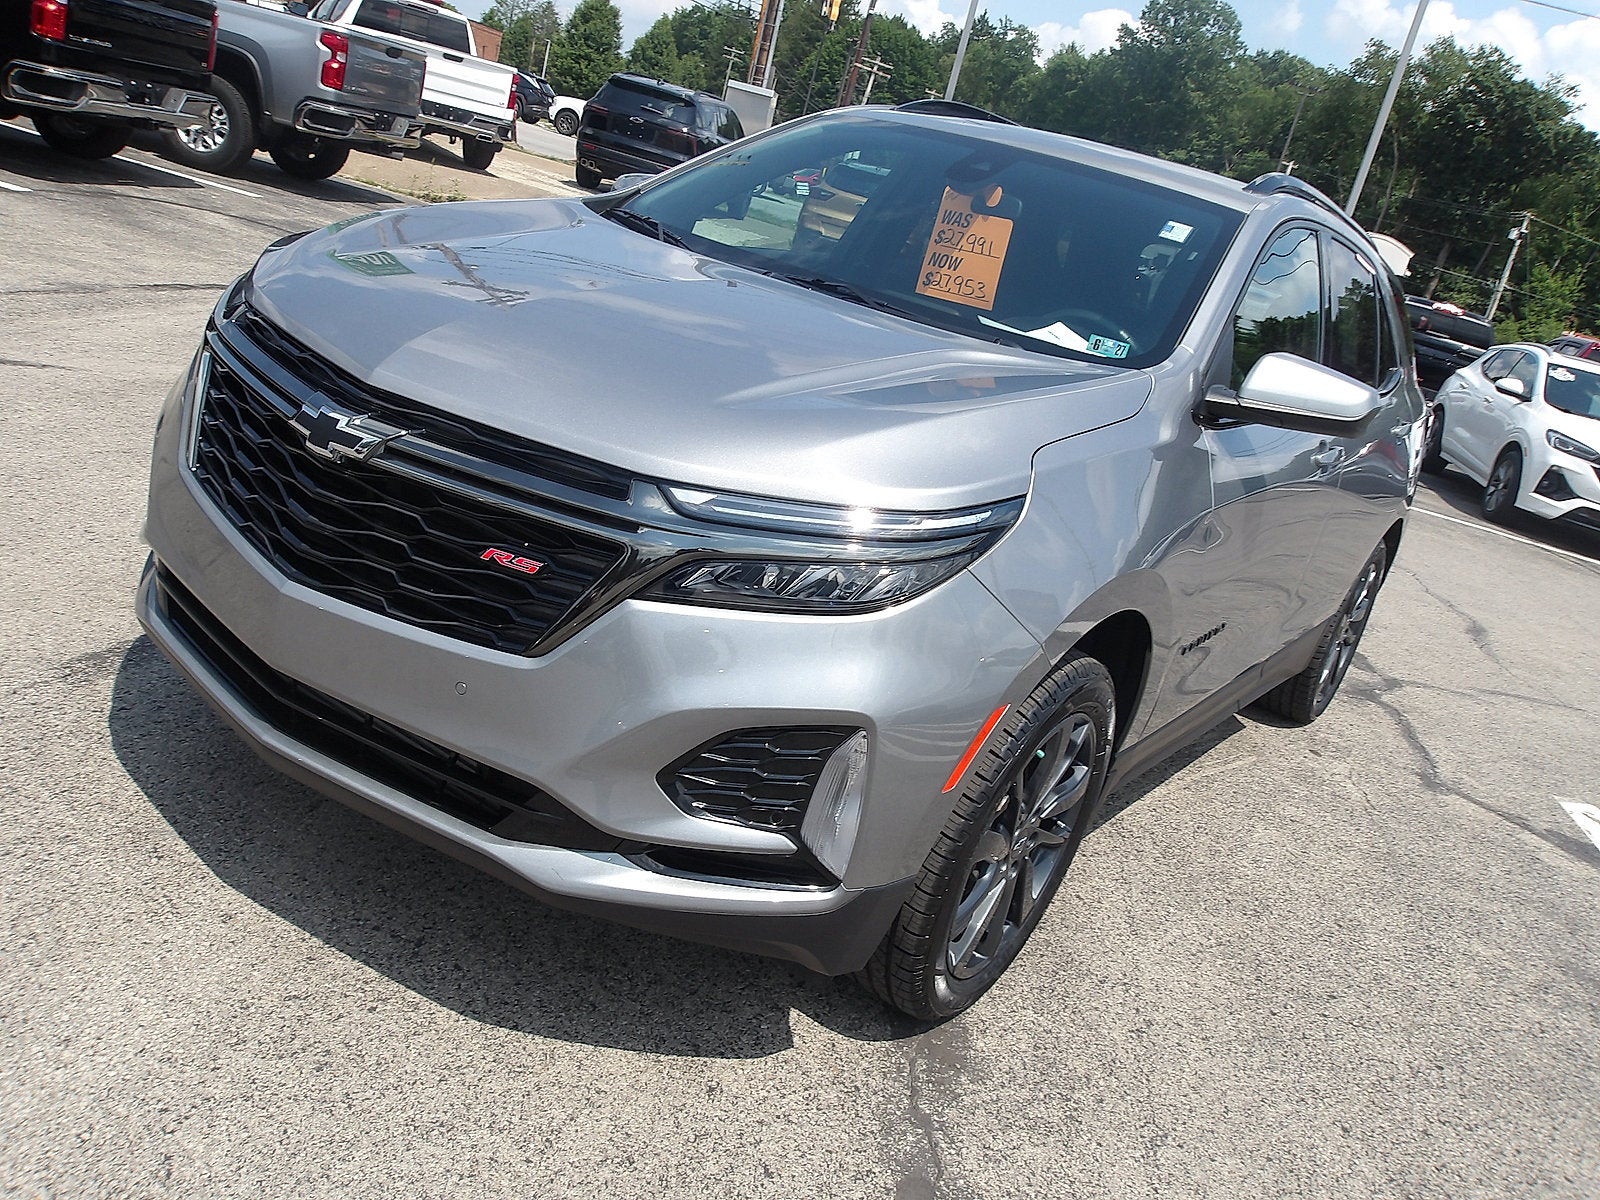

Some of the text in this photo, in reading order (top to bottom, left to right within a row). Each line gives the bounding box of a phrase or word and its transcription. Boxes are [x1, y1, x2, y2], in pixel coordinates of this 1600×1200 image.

[941, 209, 973, 228] WAS
[934, 228, 993, 256] $27,991
[928, 251, 964, 271] NOW
[922, 271, 986, 299] $27,953
[1093, 338, 1127, 357] 6 27
[480, 548, 544, 575] RS
